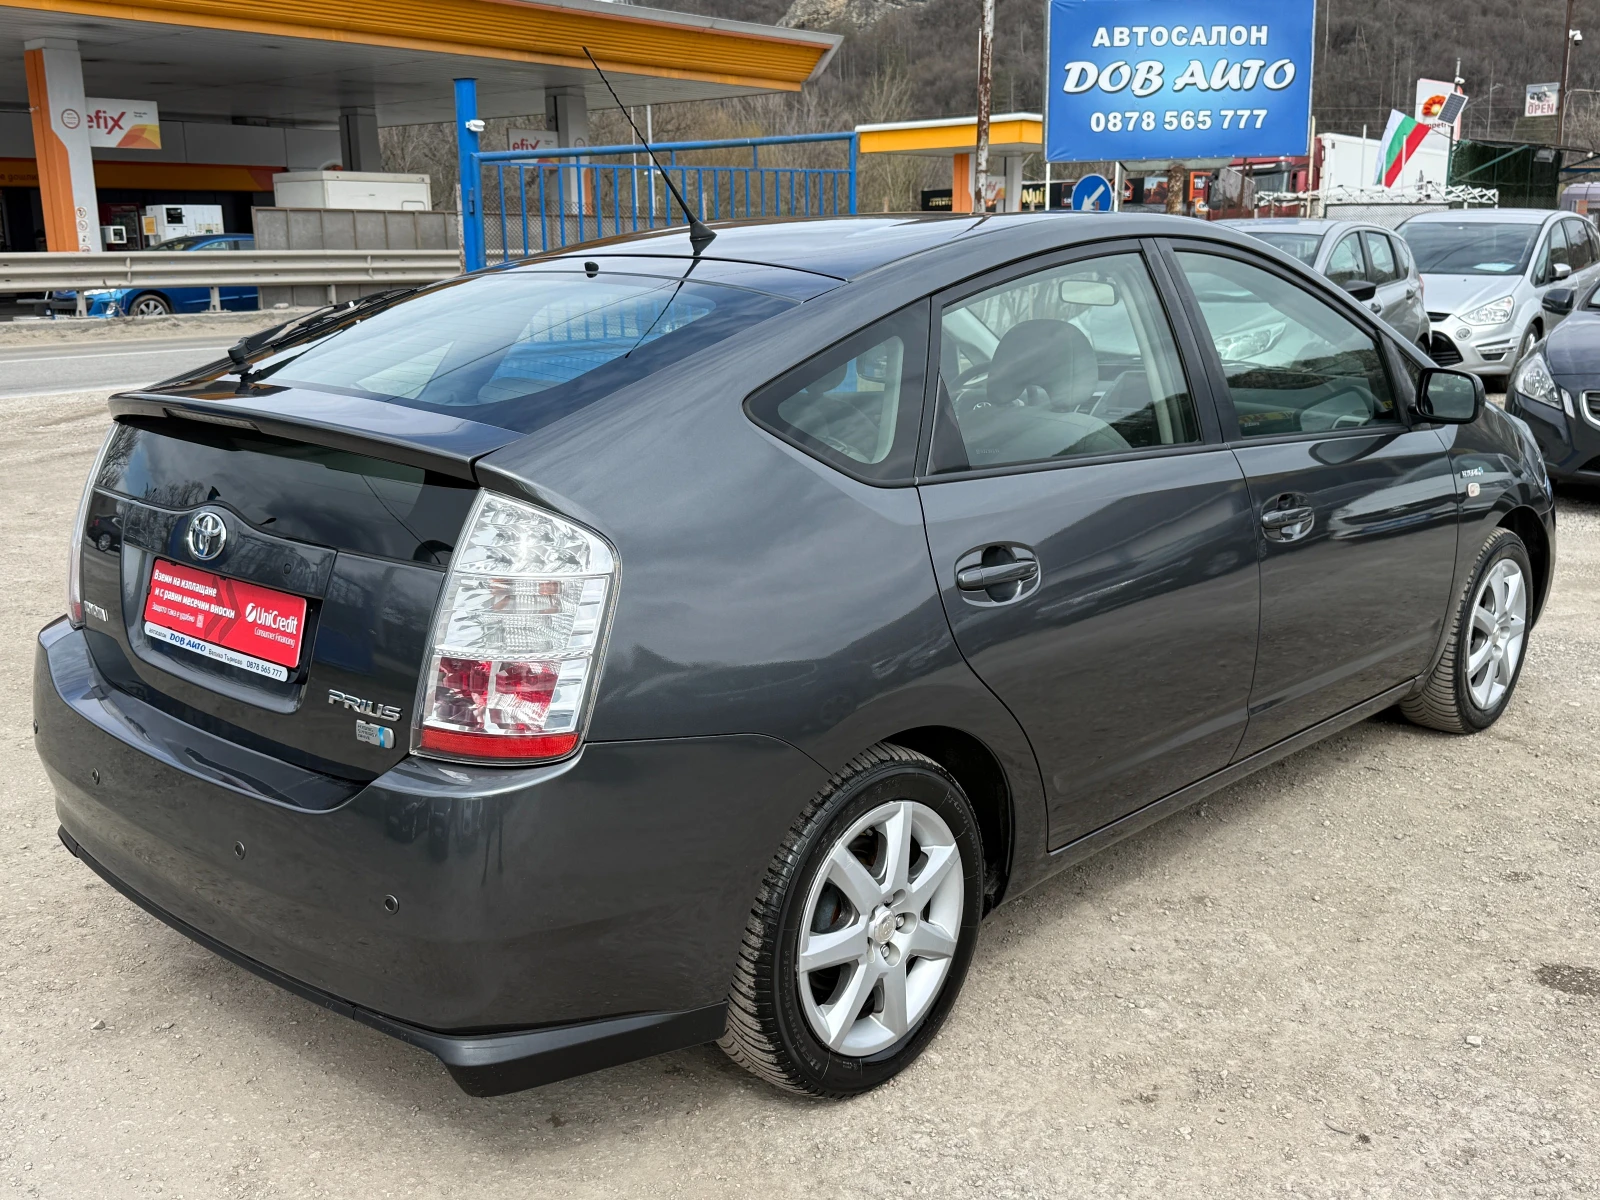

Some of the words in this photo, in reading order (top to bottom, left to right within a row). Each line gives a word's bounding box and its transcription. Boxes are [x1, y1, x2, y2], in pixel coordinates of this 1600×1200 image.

[1091, 25, 1268, 47] АВТОСАЛОН
[1063, 60, 1164, 96] DOB
[1172, 58, 1296, 91] AUTO
[1090, 111, 1156, 132] 0878
[1163, 110, 1212, 130] 565
[1220, 109, 1268, 129] 777
[1527, 103, 1554, 115] OPEN
[154, 569, 173, 584] Вземи
[173, 577, 180, 586] на
[154, 587, 160, 596] и
[159, 589, 165, 597] с
[163, 590, 182, 603] равни
[182, 596, 210, 611] месечни
[210, 604, 236, 619] вноски
[256, 606, 298, 634] UniCredit
[169, 633, 186, 645] DOB
[186, 639, 206, 652] AUTO
[246, 660, 260, 671] 0878
[260, 665, 271, 675] 565
[271, 668, 283, 678] 777
[328, 689, 402, 721] PRIUS
